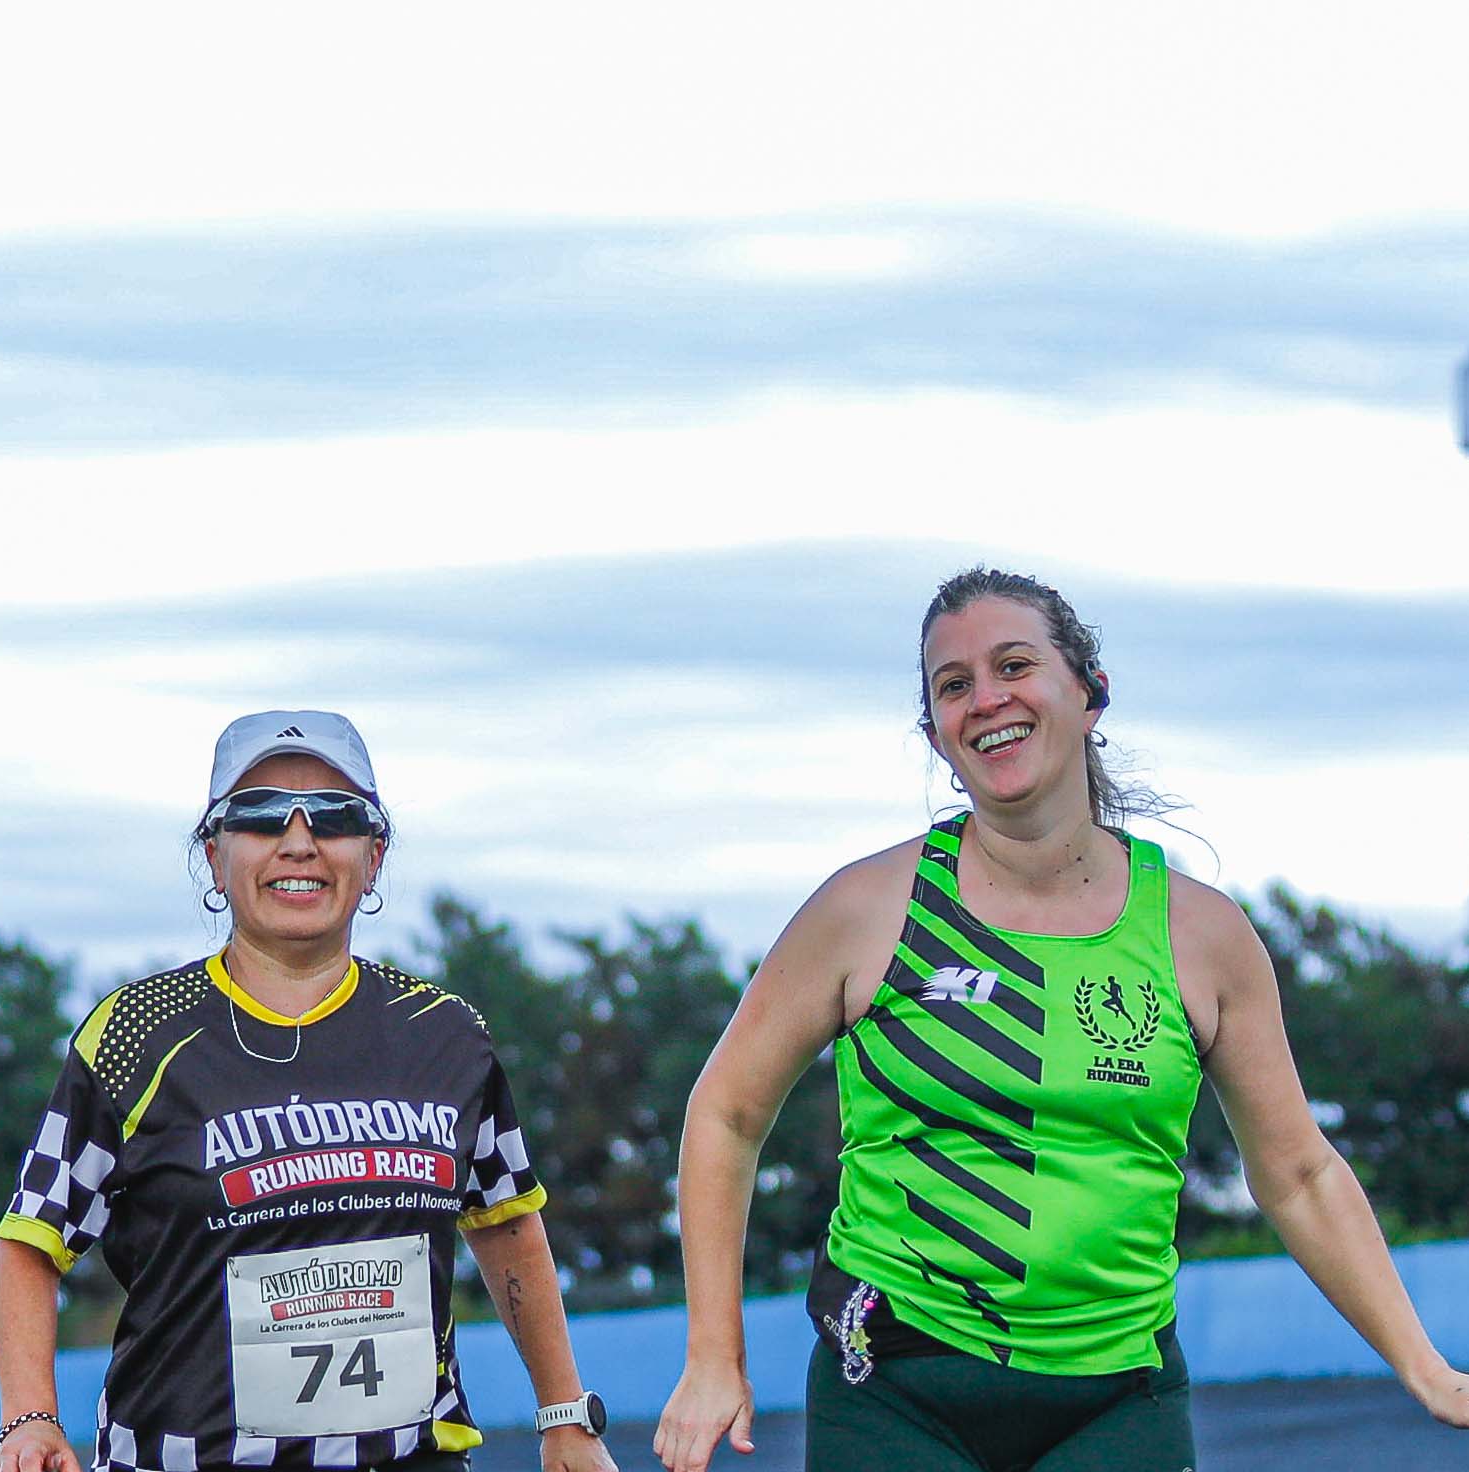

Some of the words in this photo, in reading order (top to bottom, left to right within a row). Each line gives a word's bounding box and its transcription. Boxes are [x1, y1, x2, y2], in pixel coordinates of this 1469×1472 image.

[1086, 1068, 1150, 1087] RUNNING
[1094, 1055, 1114, 1069] LA
[1117, 1058, 1145, 1073] ERA
[204, 1094, 459, 1170] AUTÓDROMO
[249, 1151, 367, 1197] RUNNING
[373, 1150, 436, 1182] RACE
[207, 1216, 226, 1231] La
[228, 1206, 285, 1227] Carrera
[289, 1200, 309, 1217] de
[312, 1198, 335, 1214] los
[338, 1194, 391, 1211] Clubes
[395, 1191, 418, 1208] del
[260, 1258, 403, 1303] AUTÓDROMO
[260, 1325, 270, 1333] La
[272, 1322, 303, 1332] Carrera
[305, 1321, 316, 1329] de
[317, 1320, 330, 1329] los
[331, 1317, 358, 1327] Clubes
[359, 1314, 372, 1323] del
[373, 1311, 405, 1322] Noroeste
[286, 1293, 345, 1317] RUNNING
[349, 1291, 382, 1308] RACE
[291, 1338, 384, 1404] 74
